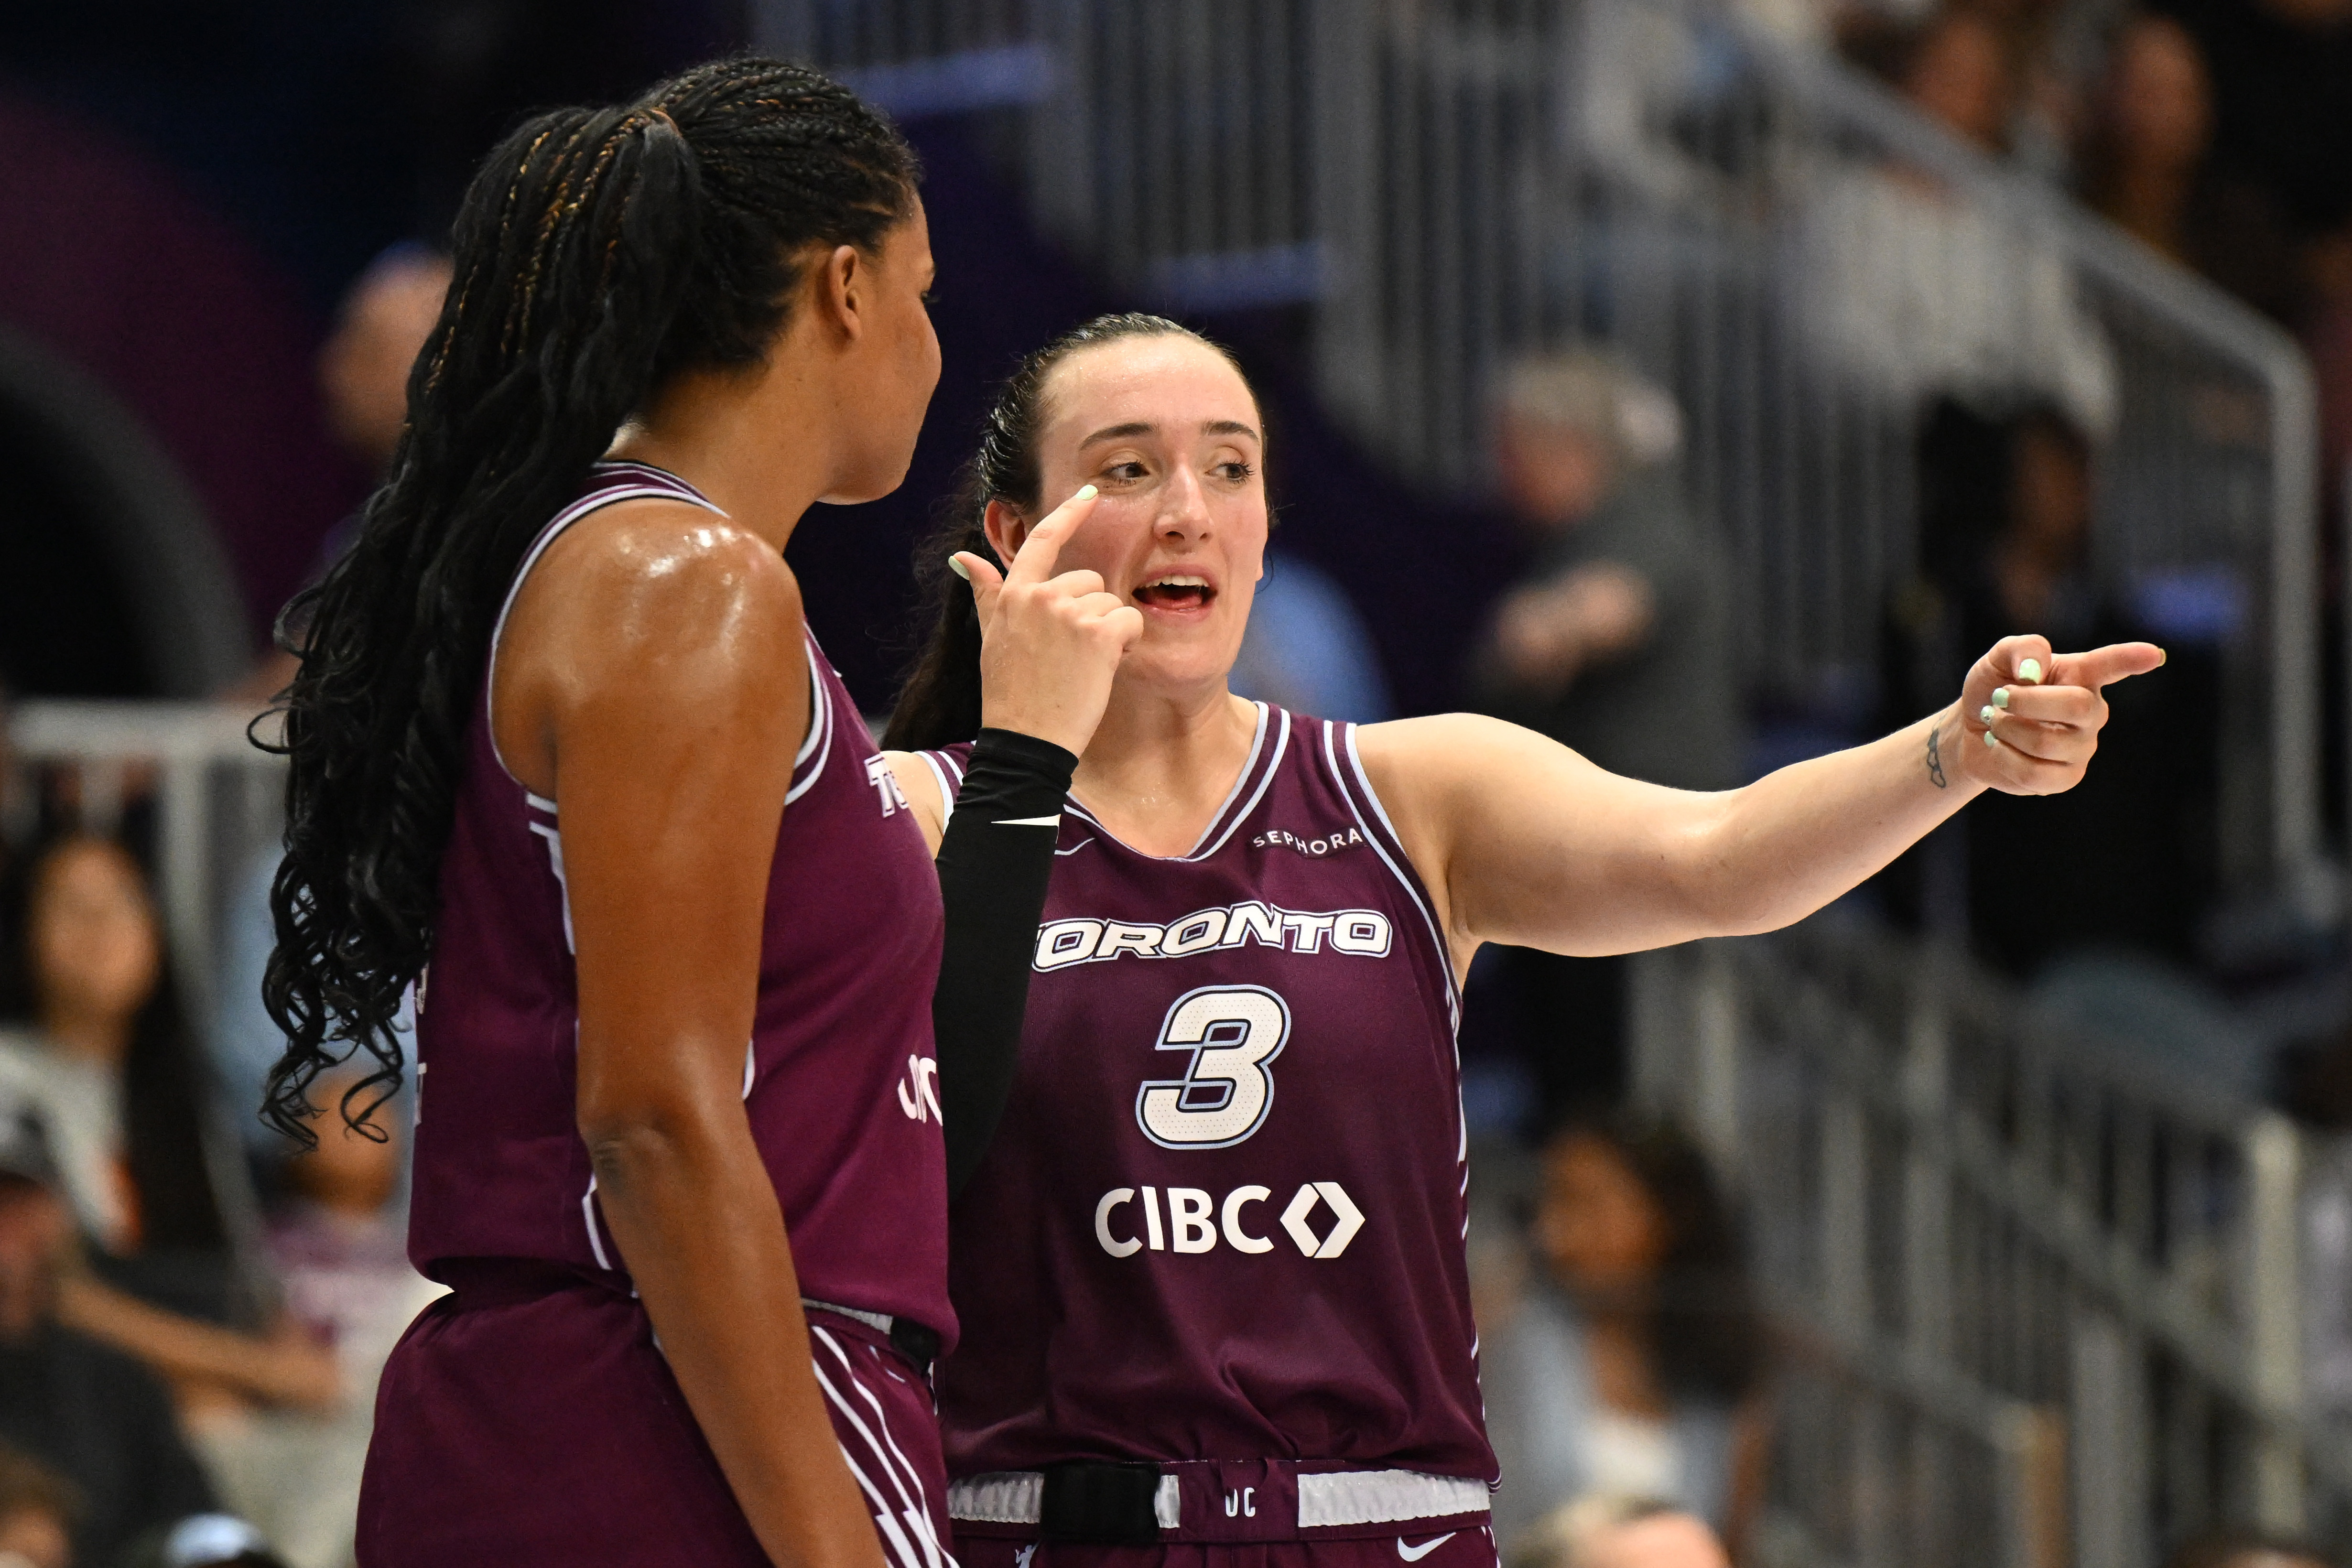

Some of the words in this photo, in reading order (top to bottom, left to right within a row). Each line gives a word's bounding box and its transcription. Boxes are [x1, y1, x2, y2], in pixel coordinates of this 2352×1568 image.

[1253, 828, 1363, 854] SEPHORA
[1031, 900, 1393, 973] ORONTO
[1135, 982, 1291, 1150] 3
[1095, 1185, 1275, 1258] CIBC
